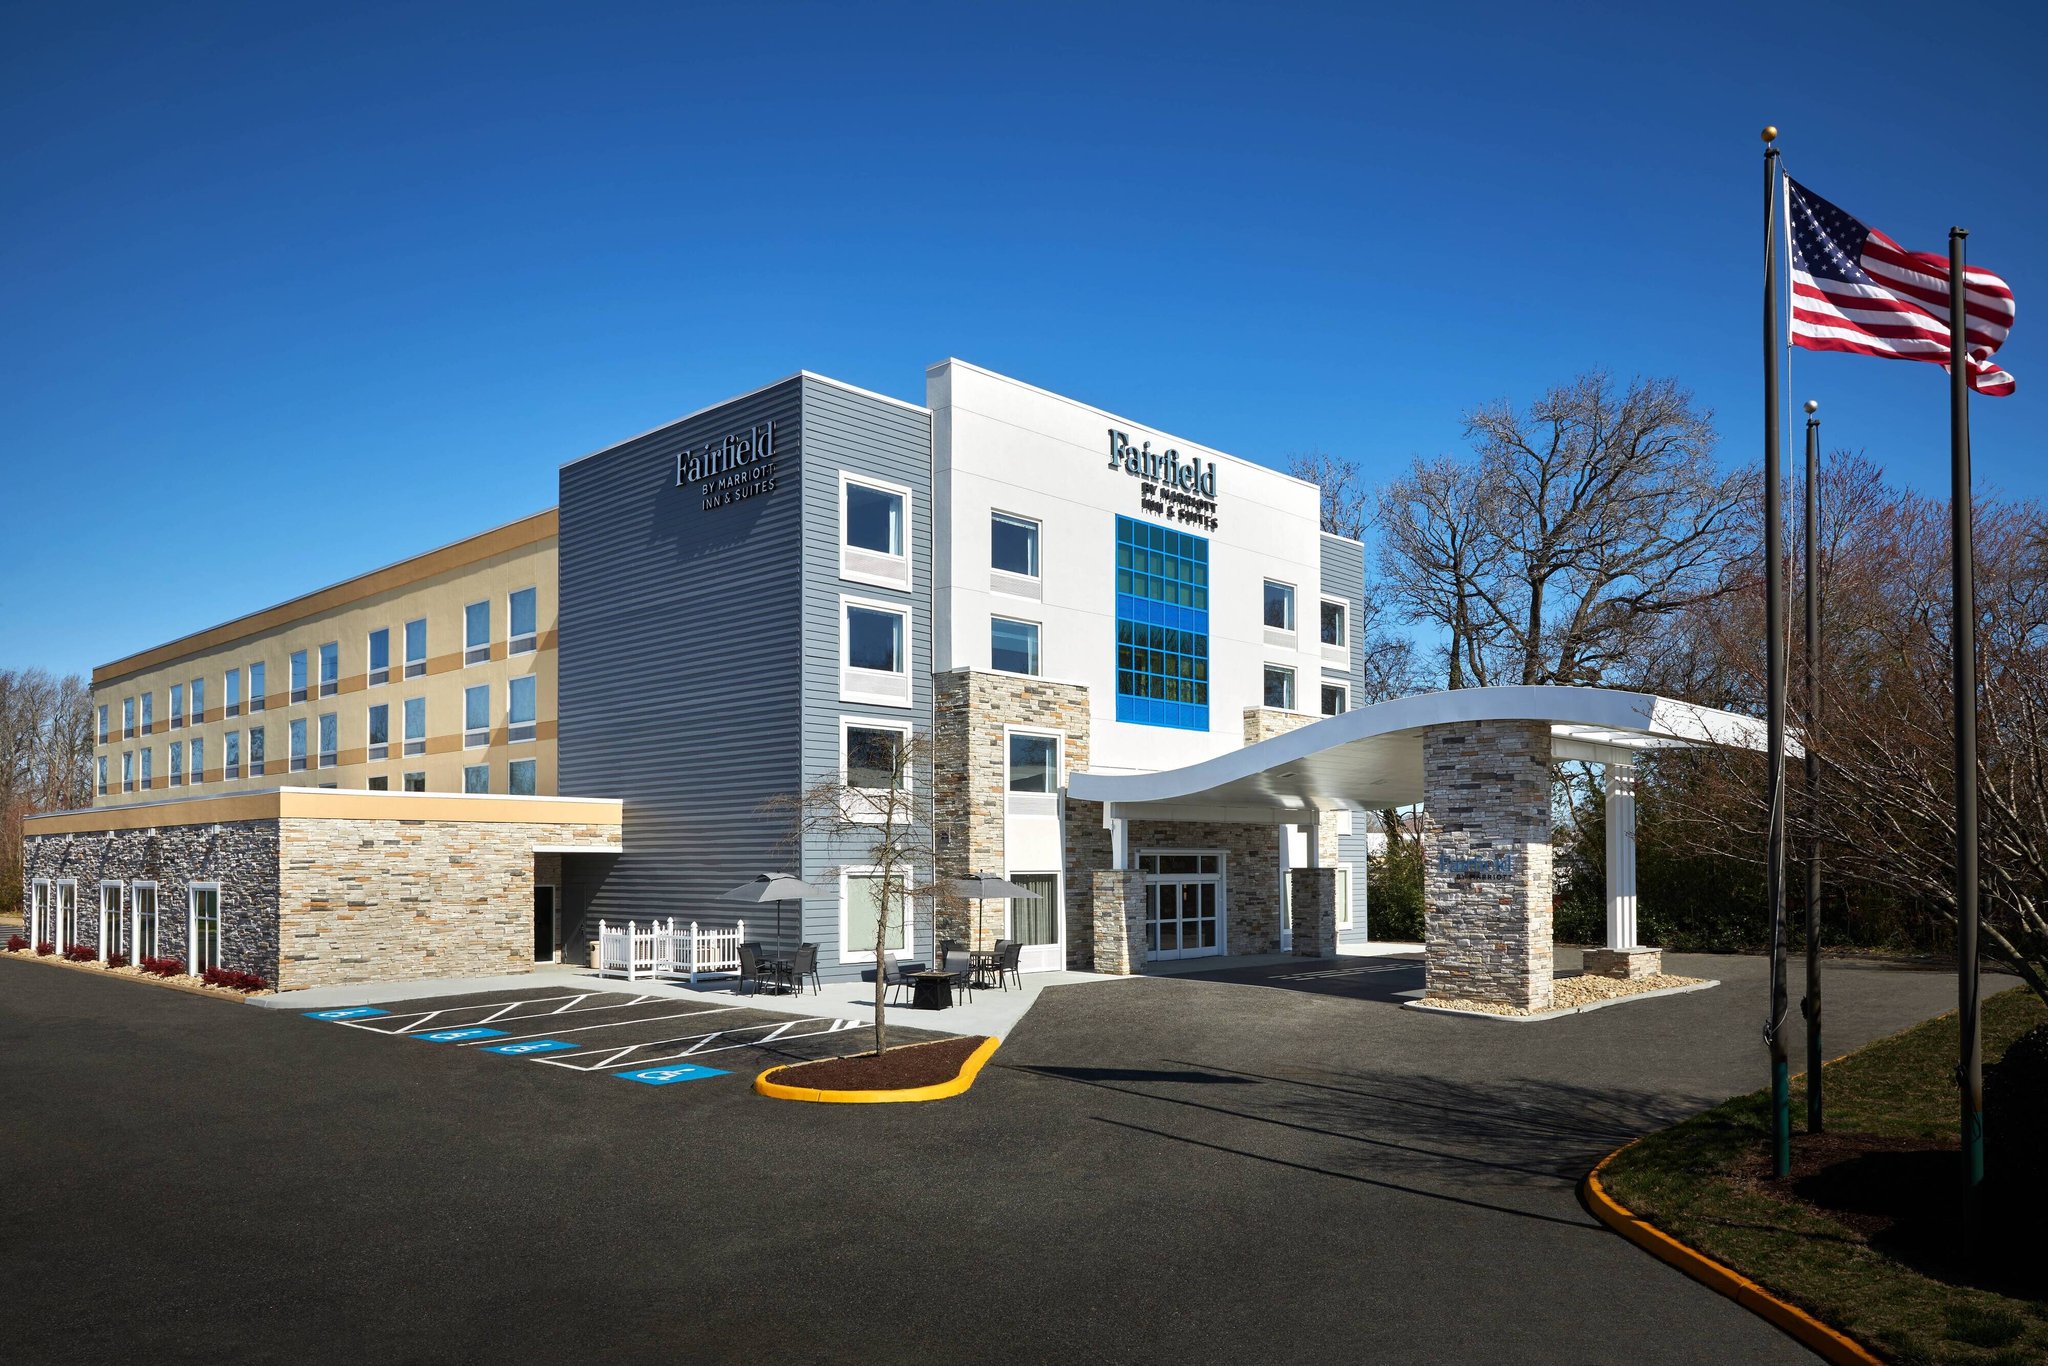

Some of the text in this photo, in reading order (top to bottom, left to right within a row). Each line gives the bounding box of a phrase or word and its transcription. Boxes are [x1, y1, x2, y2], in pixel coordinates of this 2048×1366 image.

[675, 420, 776, 487] Fairfield
[1108, 428, 1217, 500] Fairfield
[702, 463, 775, 495] BY MARRIOTT
[702, 478, 776, 510] INN & SUITES
[1141, 482, 1218, 514] BY MARRIOTT
[1141, 498, 1219, 531] INN & SUITES
